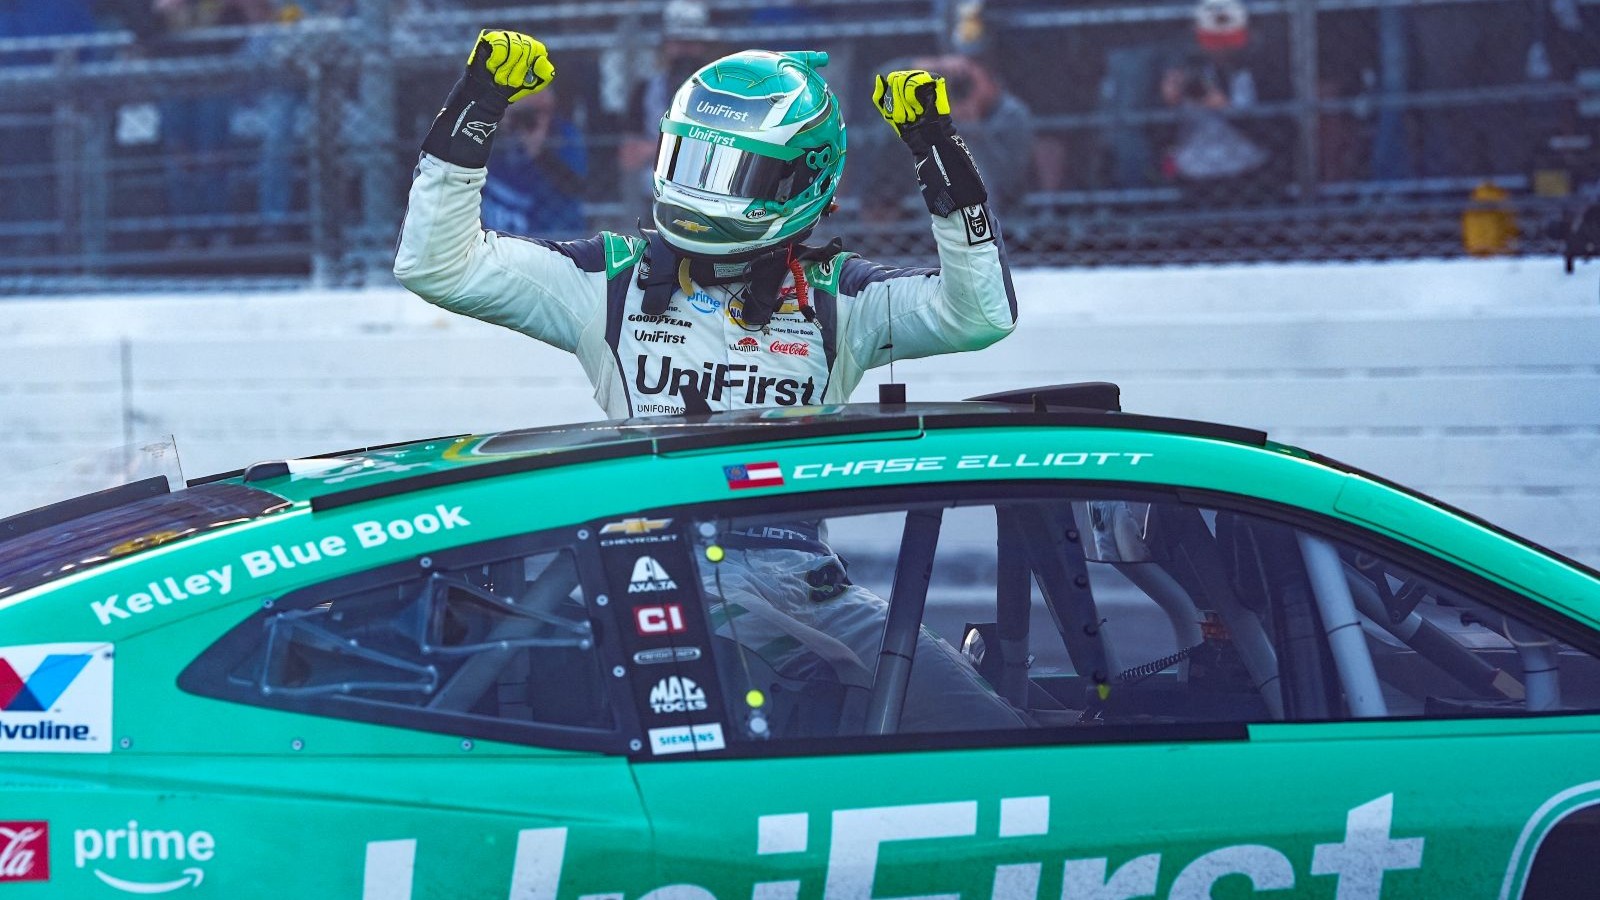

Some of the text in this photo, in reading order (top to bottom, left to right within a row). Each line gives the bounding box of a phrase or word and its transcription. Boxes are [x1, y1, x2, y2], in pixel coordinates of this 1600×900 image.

[696, 101, 749, 123] UniFirst
[688, 127, 736, 147] UniFirst
[971, 217, 984, 234] sfi
[687, 290, 721, 308] prime
[627, 314, 693, 329] GOODYEAR
[634, 328, 686, 345] UniFirst
[635, 354, 815, 406] UniFirst
[637, 404, 686, 415] UNIFORMS
[792, 452, 1154, 480] CHASE ELLIOTT
[600, 534, 678, 547] CHEVROLET
[90, 503, 471, 626] Kelley Blue Book
[638, 606, 683, 632] CI
[649, 675, 706, 703] MAC
[651, 700, 708, 715] TOOLS
[659, 732, 715, 746] SIEMNS
[74, 819, 215, 868] prime
